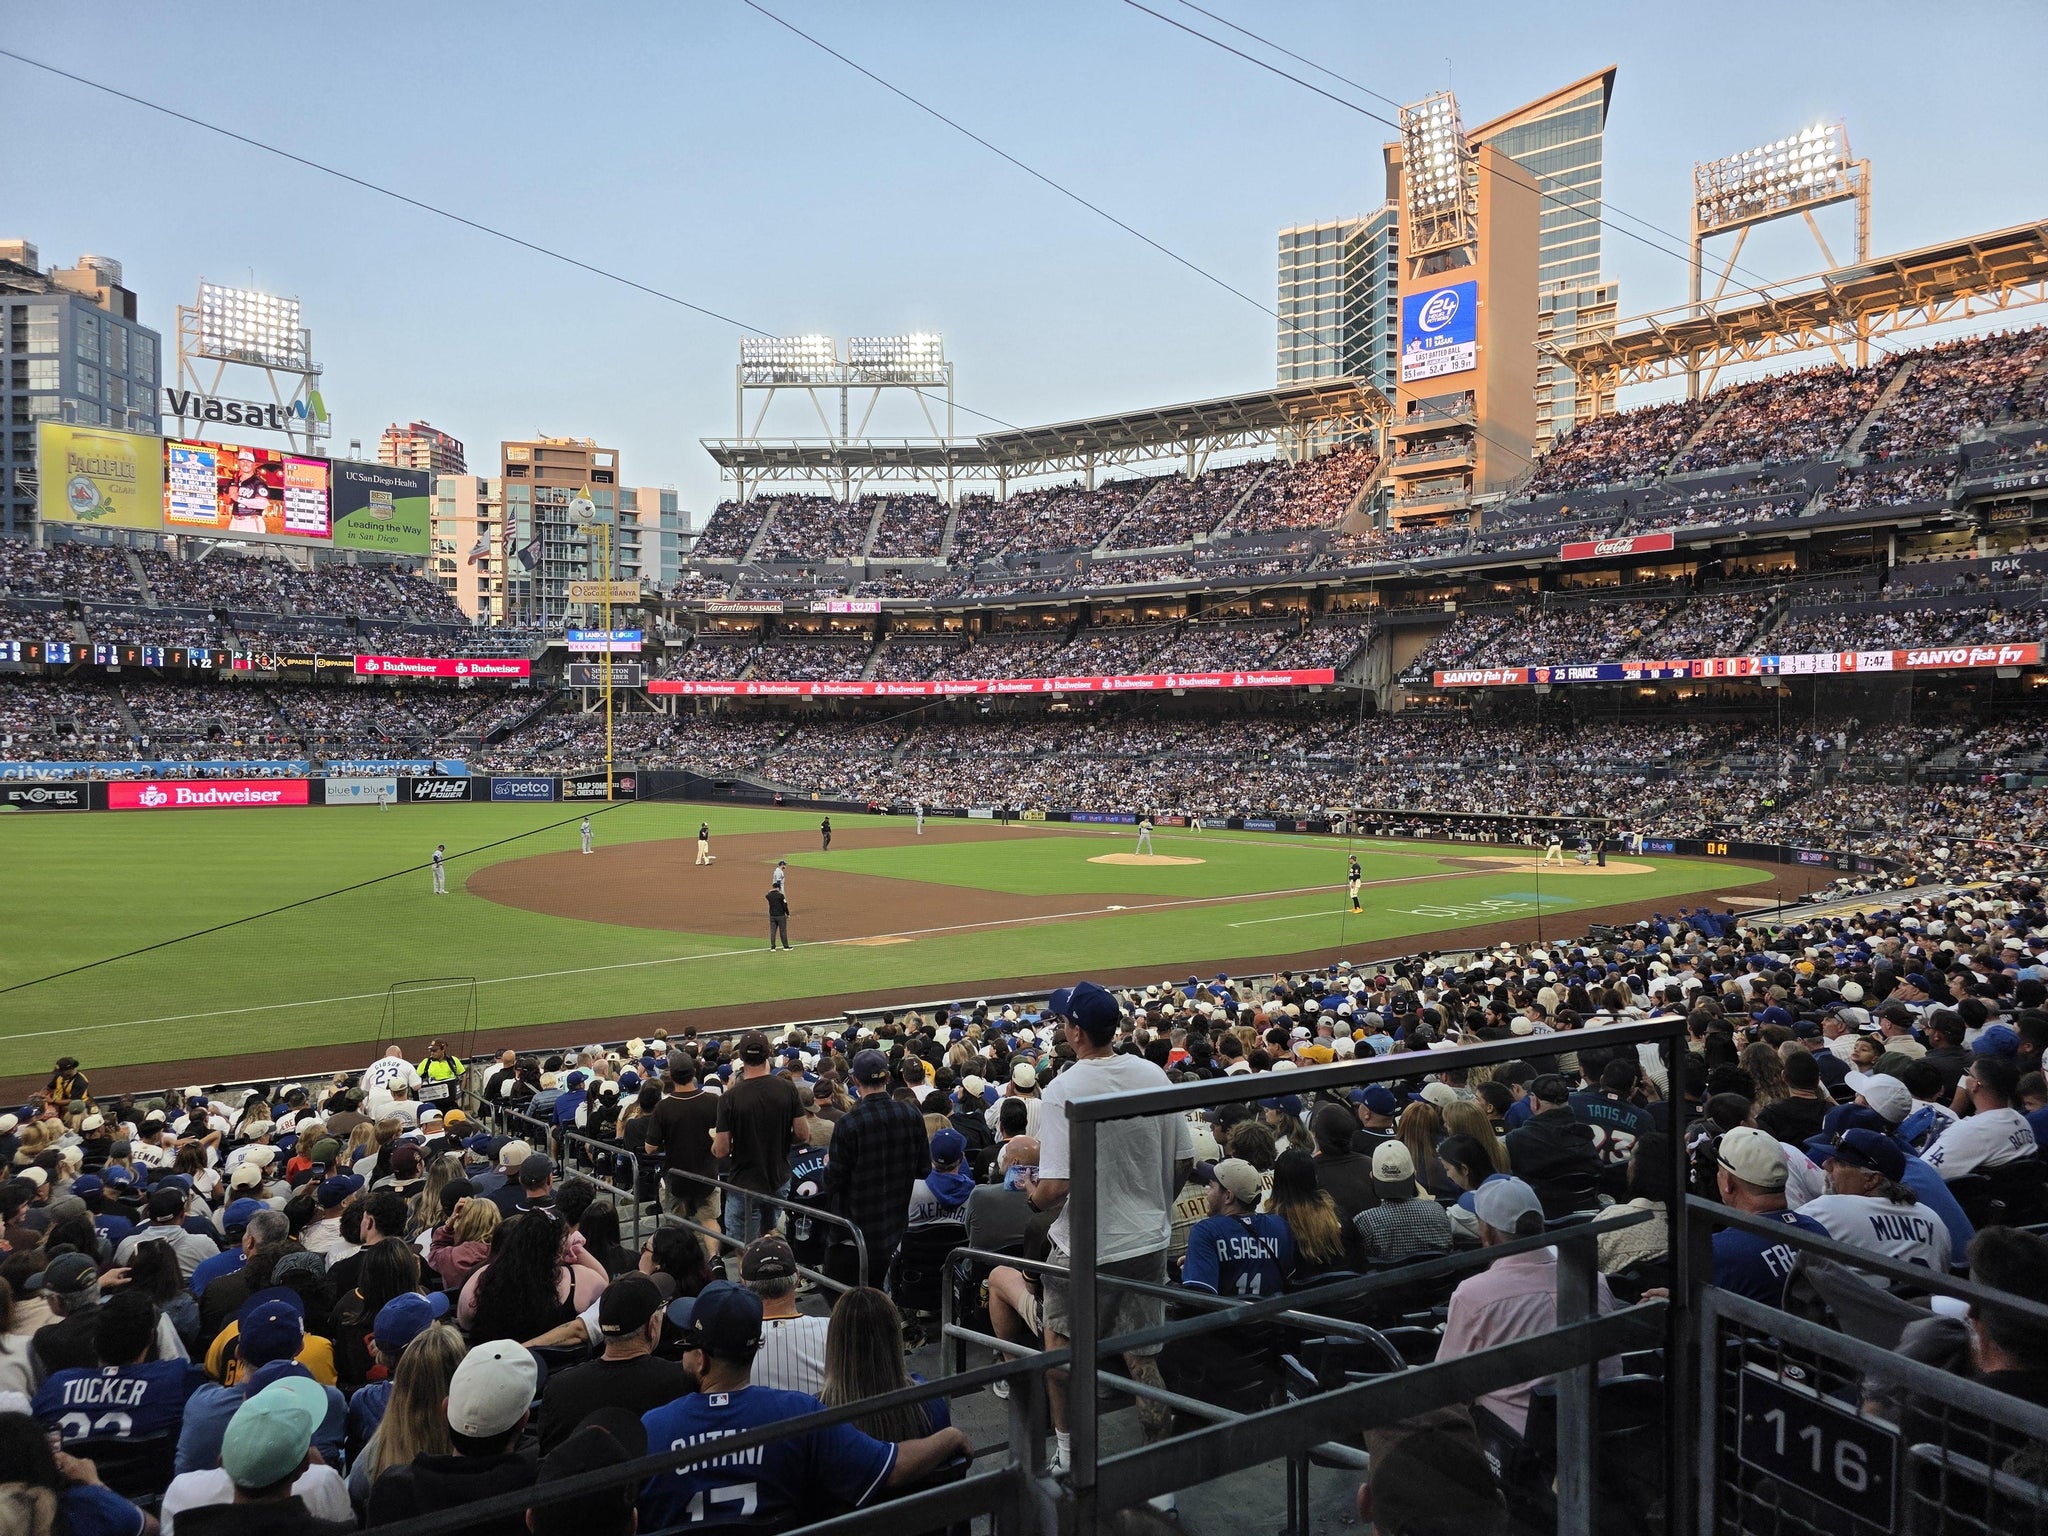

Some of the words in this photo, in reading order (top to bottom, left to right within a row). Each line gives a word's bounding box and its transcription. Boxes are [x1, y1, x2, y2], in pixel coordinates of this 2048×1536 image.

[1429, 298, 1456, 314] 24
[1415, 353, 1428, 361] LAST
[1428, 350, 1447, 359] BATTED
[1448, 346, 1460, 355] BALL
[166, 388, 283, 430] Viasat
[67, 452, 136, 478] PACIFICO
[346, 471, 359, 481] UC
[358, 473, 373, 482] San
[373, 475, 394, 487] Diego
[394, 477, 418, 488] Health
[1993, 478, 2025, 490] STEVE
[2030, 475, 2040, 485] 6
[371, 491, 391, 500] BEST
[347, 520, 384, 532] Leading
[386, 523, 400, 532] the
[402, 525, 422, 536] Way
[347, 531, 356, 539] in
[358, 532, 374, 541] San
[376, 534, 399, 544] Diego
[1991, 558, 2022, 573] RAK
[706, 602, 749, 613] Tarantino
[749, 604, 782, 612] SAUSAGES
[30, 646, 38, 657] F
[63, 644, 70, 653] 5
[80, 648, 88, 659] F
[128, 651, 135, 661] F
[157, 647, 164, 656] 3
[174, 652, 181, 663] F
[247, 652, 253, 660] 2
[1906, 649, 1968, 666] SANYO
[1969, 649, 1996, 666] fish
[1997, 647, 2024, 664] fry
[63, 654, 70, 664] 4
[111, 656, 119, 665] 6
[201, 658, 212, 668] 22
[219, 654, 225, 664] F
[261, 657, 267, 666] 5
[1863, 656, 1885, 667] 7:47
[383, 661, 437, 672] Budweiser
[471, 664, 521, 673] Budweiser
[1703, 660, 1714, 676] 0
[1726, 659, 1737, 675] 0
[1750, 657, 1761, 675] 2
[1443, 671, 1482, 684] SANYO
[1483, 671, 1501, 684] fish
[1502, 670, 1518, 684] fry
[1555, 668, 1566, 680] 25
[1568, 666, 1598, 680] FRANCE
[1650, 668, 1660, 679] 10
[1673, 667, 1684, 678] 29
[1054, 681, 1092, 689] Budweiser
[1114, 679, 1154, 687] Budweiser
[1179, 677, 1221, 686] Budweiser
[1247, 675, 1292, 684] Budweiser
[823, 685, 864, 693] Budweiser
[944, 684, 978, 692] Budweiser
[998, 683, 1033, 691] Budweiser
[327, 785, 351, 795] blue
[511, 781, 550, 795] petco
[576, 782, 591, 790] SLAP
[175, 787, 282, 804] Budweiser
[429, 791, 464, 799] POWER
[576, 789, 594, 797] CHEESE
[1651, 841, 1667, 850] blue
[1586, 1104, 1620, 1122] TATIS
[1868, 1214, 1935, 1246] MUNCY
[1216, 1238, 1231, 1263] R.
[1230, 1236, 1279, 1261] SASAKI
[1235, 1271, 1262, 1296] 11
[63, 1377, 149, 1407] TUCKER
[1763, 1407, 1868, 1493] 116
[685, 1481, 758, 1522] 17
